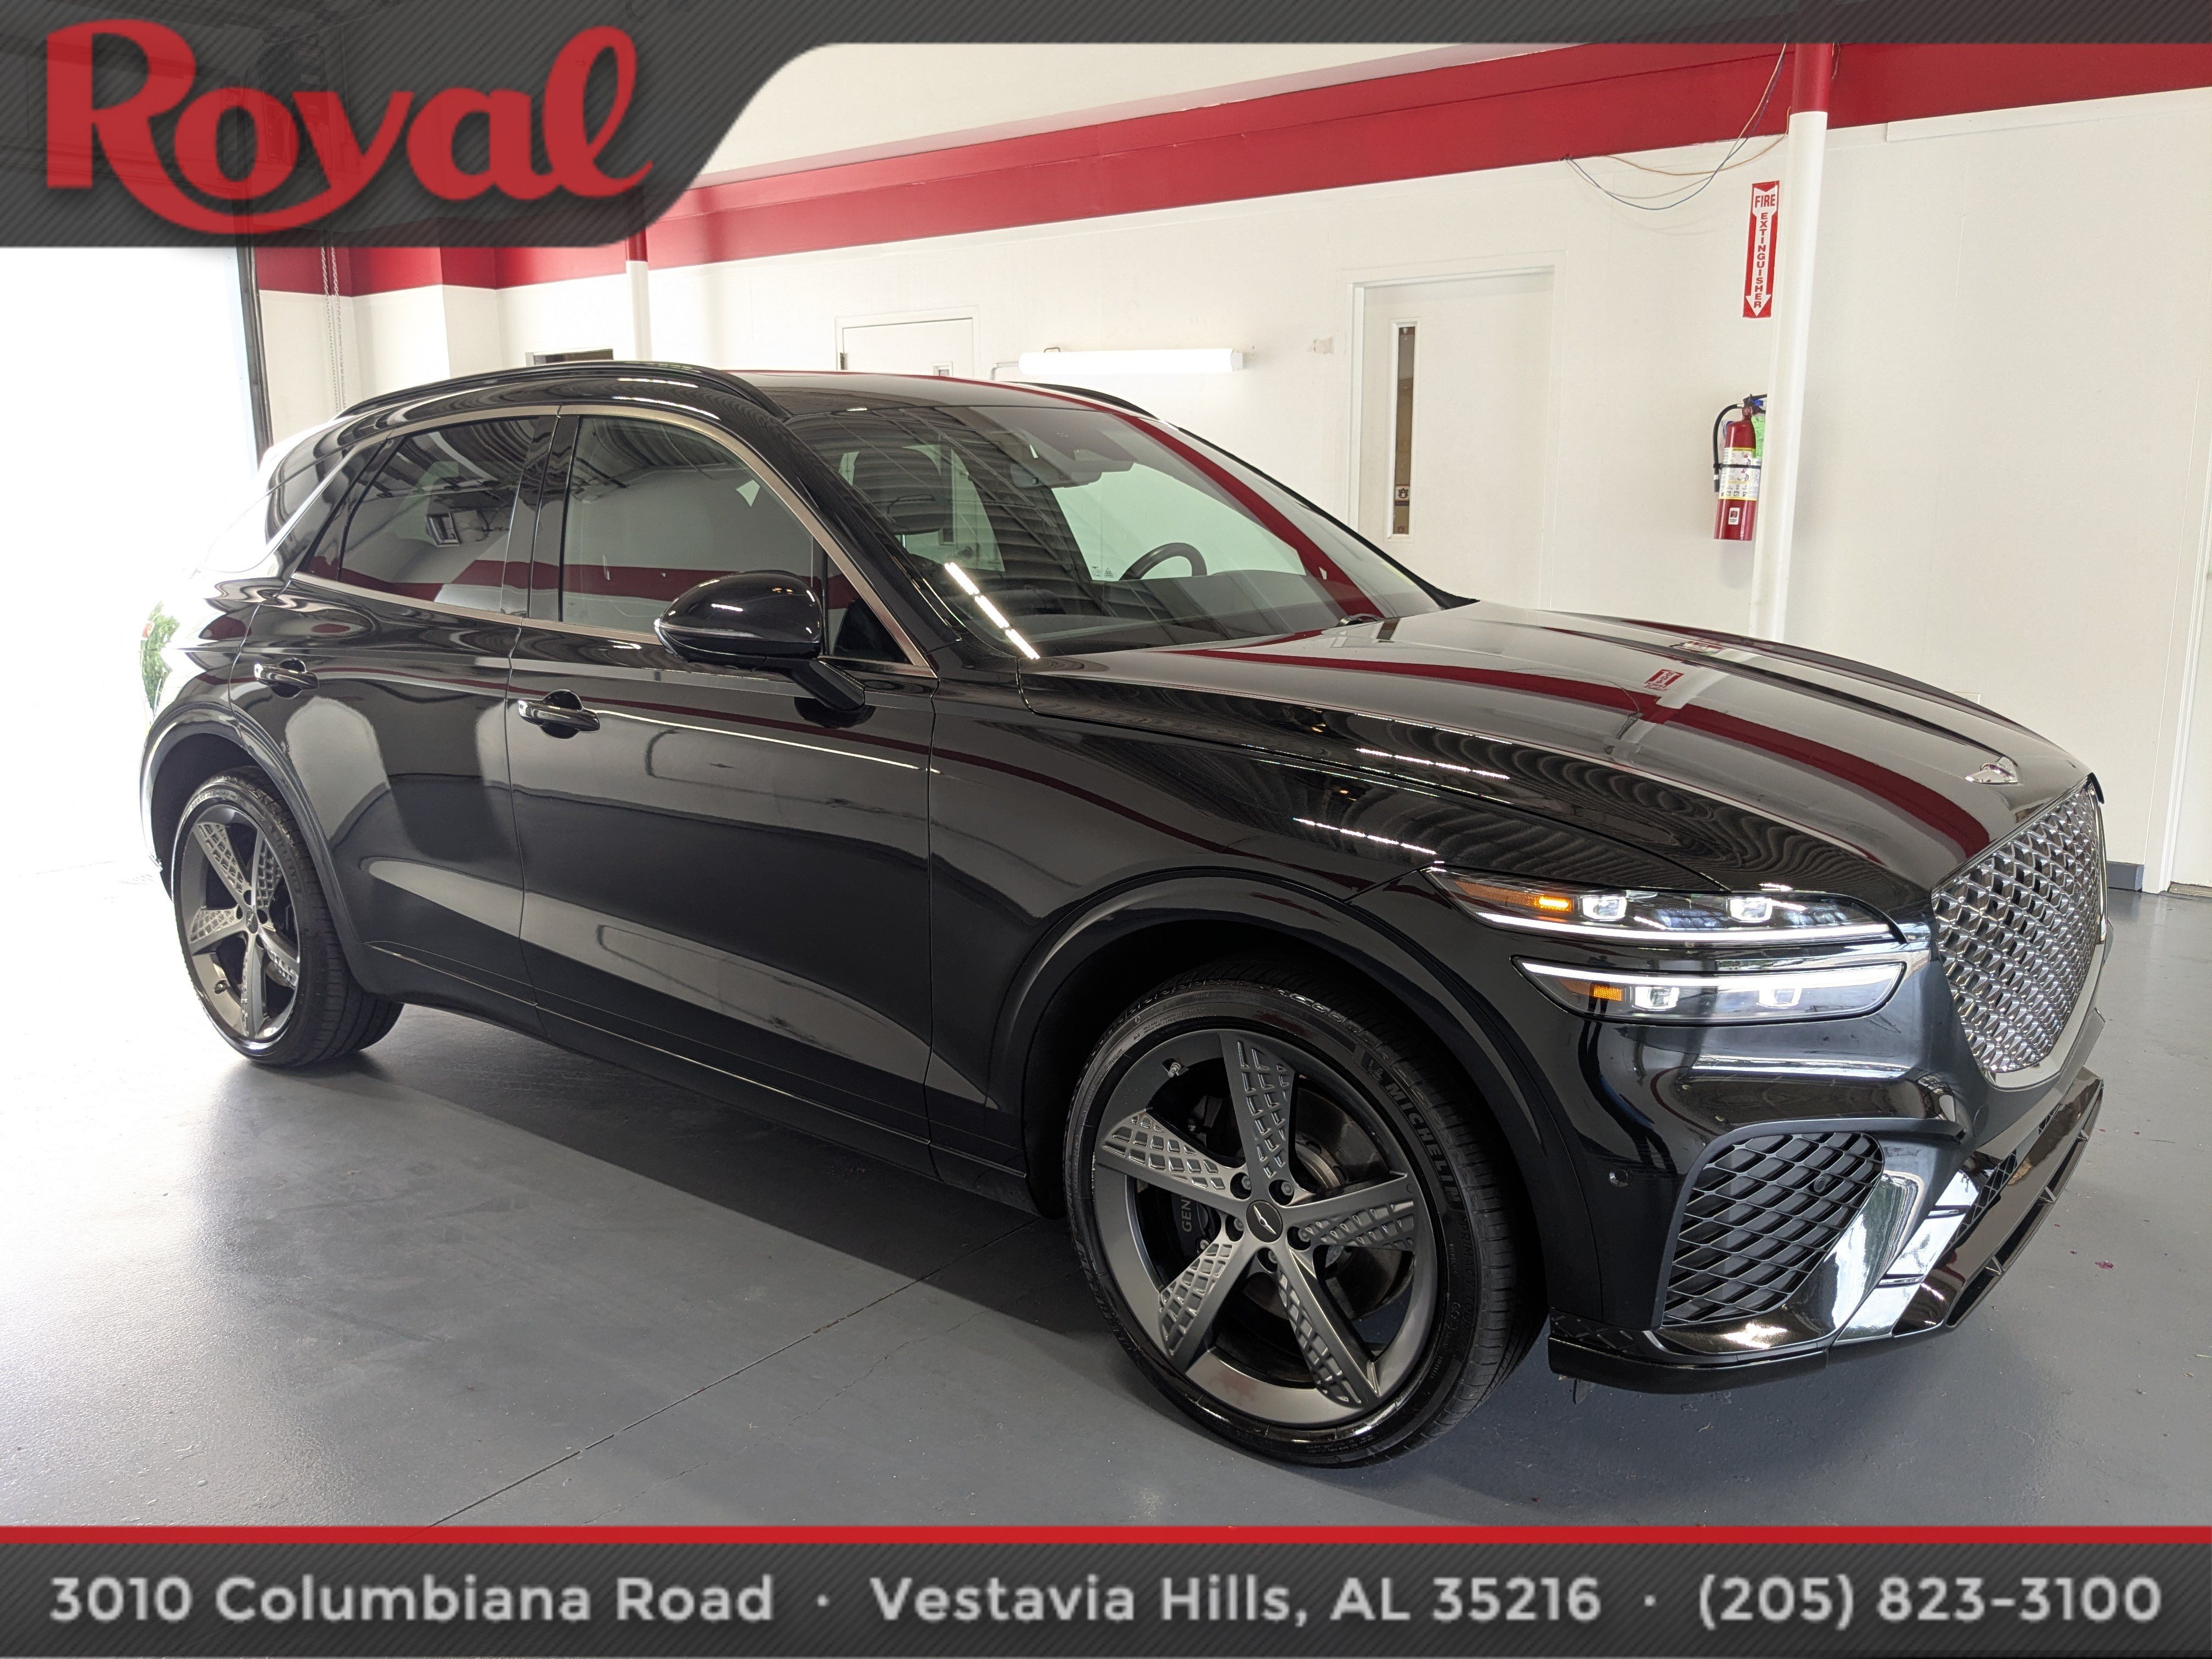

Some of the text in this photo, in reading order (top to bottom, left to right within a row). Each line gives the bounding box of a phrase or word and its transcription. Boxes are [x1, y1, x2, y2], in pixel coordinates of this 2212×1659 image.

[1754, 194, 1776, 208] FIRE
[1753, 212, 1768, 308] EXTINGUISHER
[1384, 1083, 1462, 1202] MICHELIN
[1177, 1198, 1192, 1233] GEN
